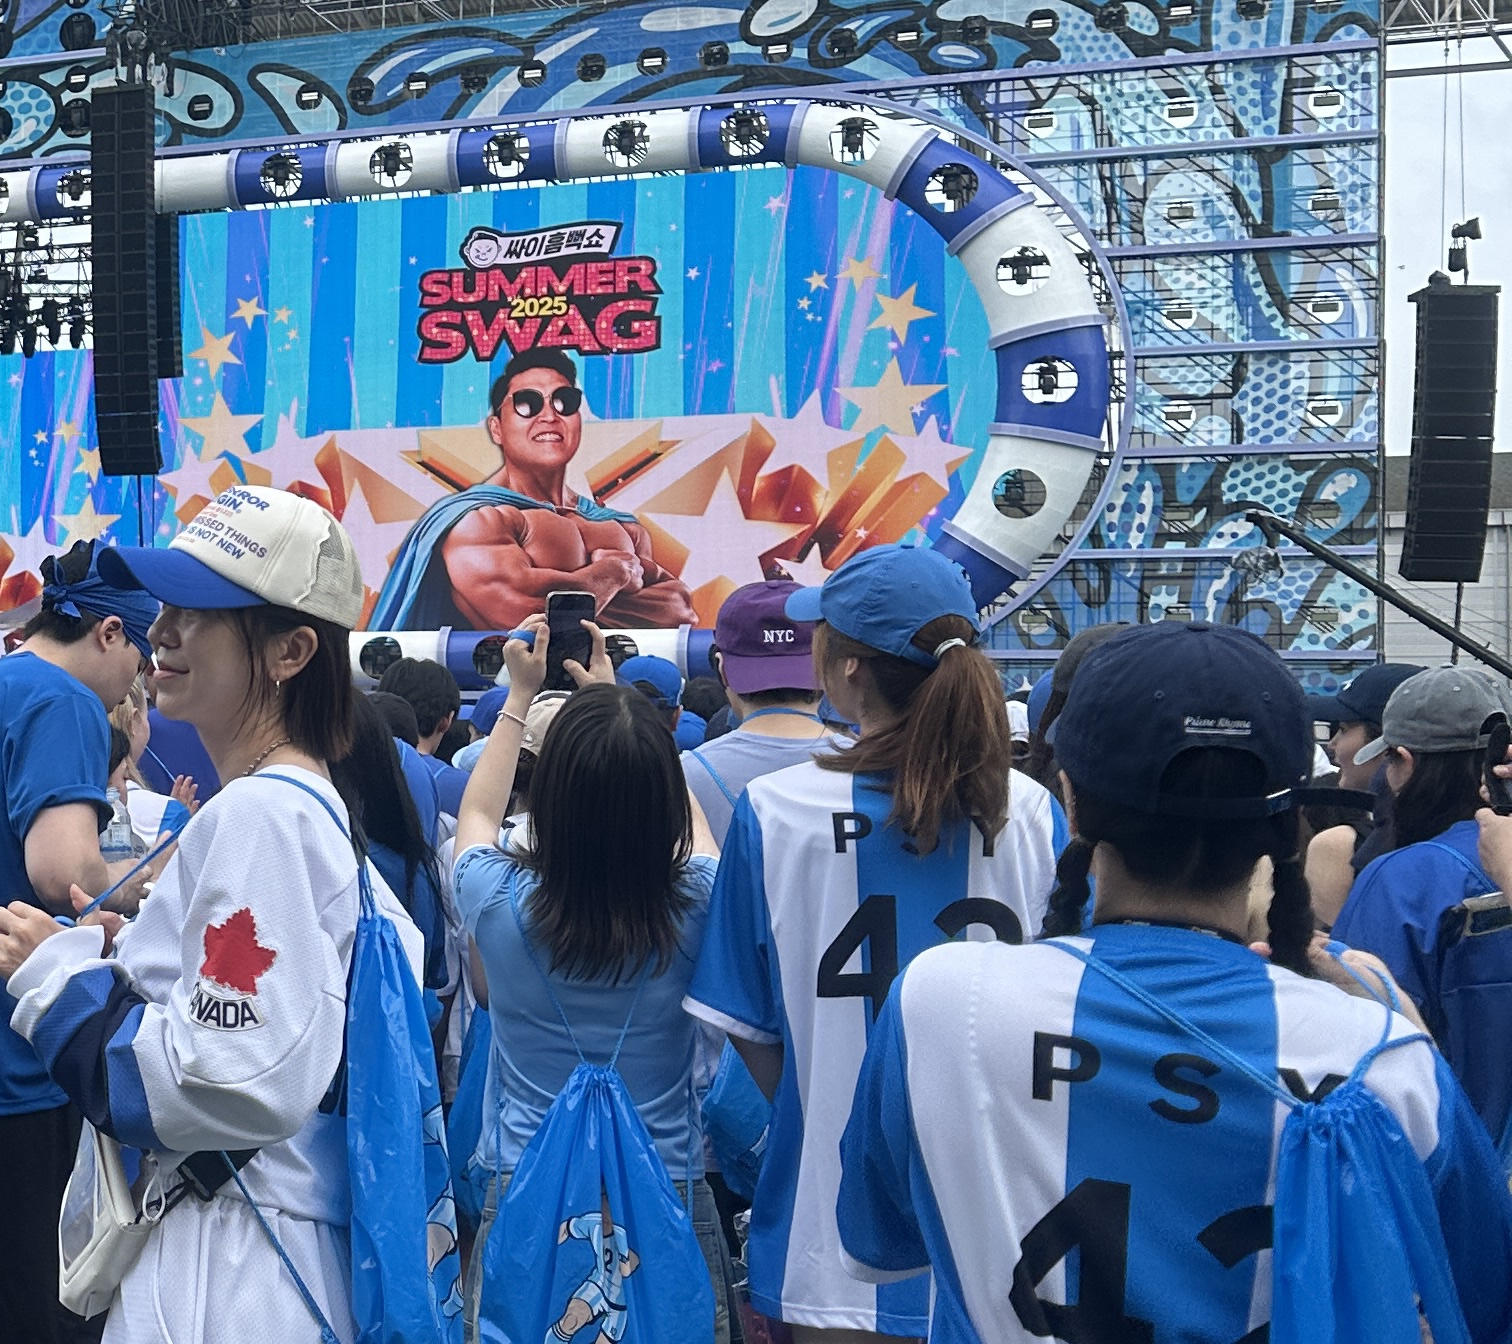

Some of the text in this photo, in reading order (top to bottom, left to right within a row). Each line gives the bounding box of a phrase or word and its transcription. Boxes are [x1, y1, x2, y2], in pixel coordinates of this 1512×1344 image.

[421, 260, 658, 305] SUMMER
[510, 296, 567, 317] 2025
[420, 299, 657, 361] SWAG
[195, 528, 219, 543] NOT
[216, 537, 246, 560] NEW
[226, 527, 268, 558] THINGS
[763, 629, 795, 643] NYC
[832, 812, 1009, 857] PY
